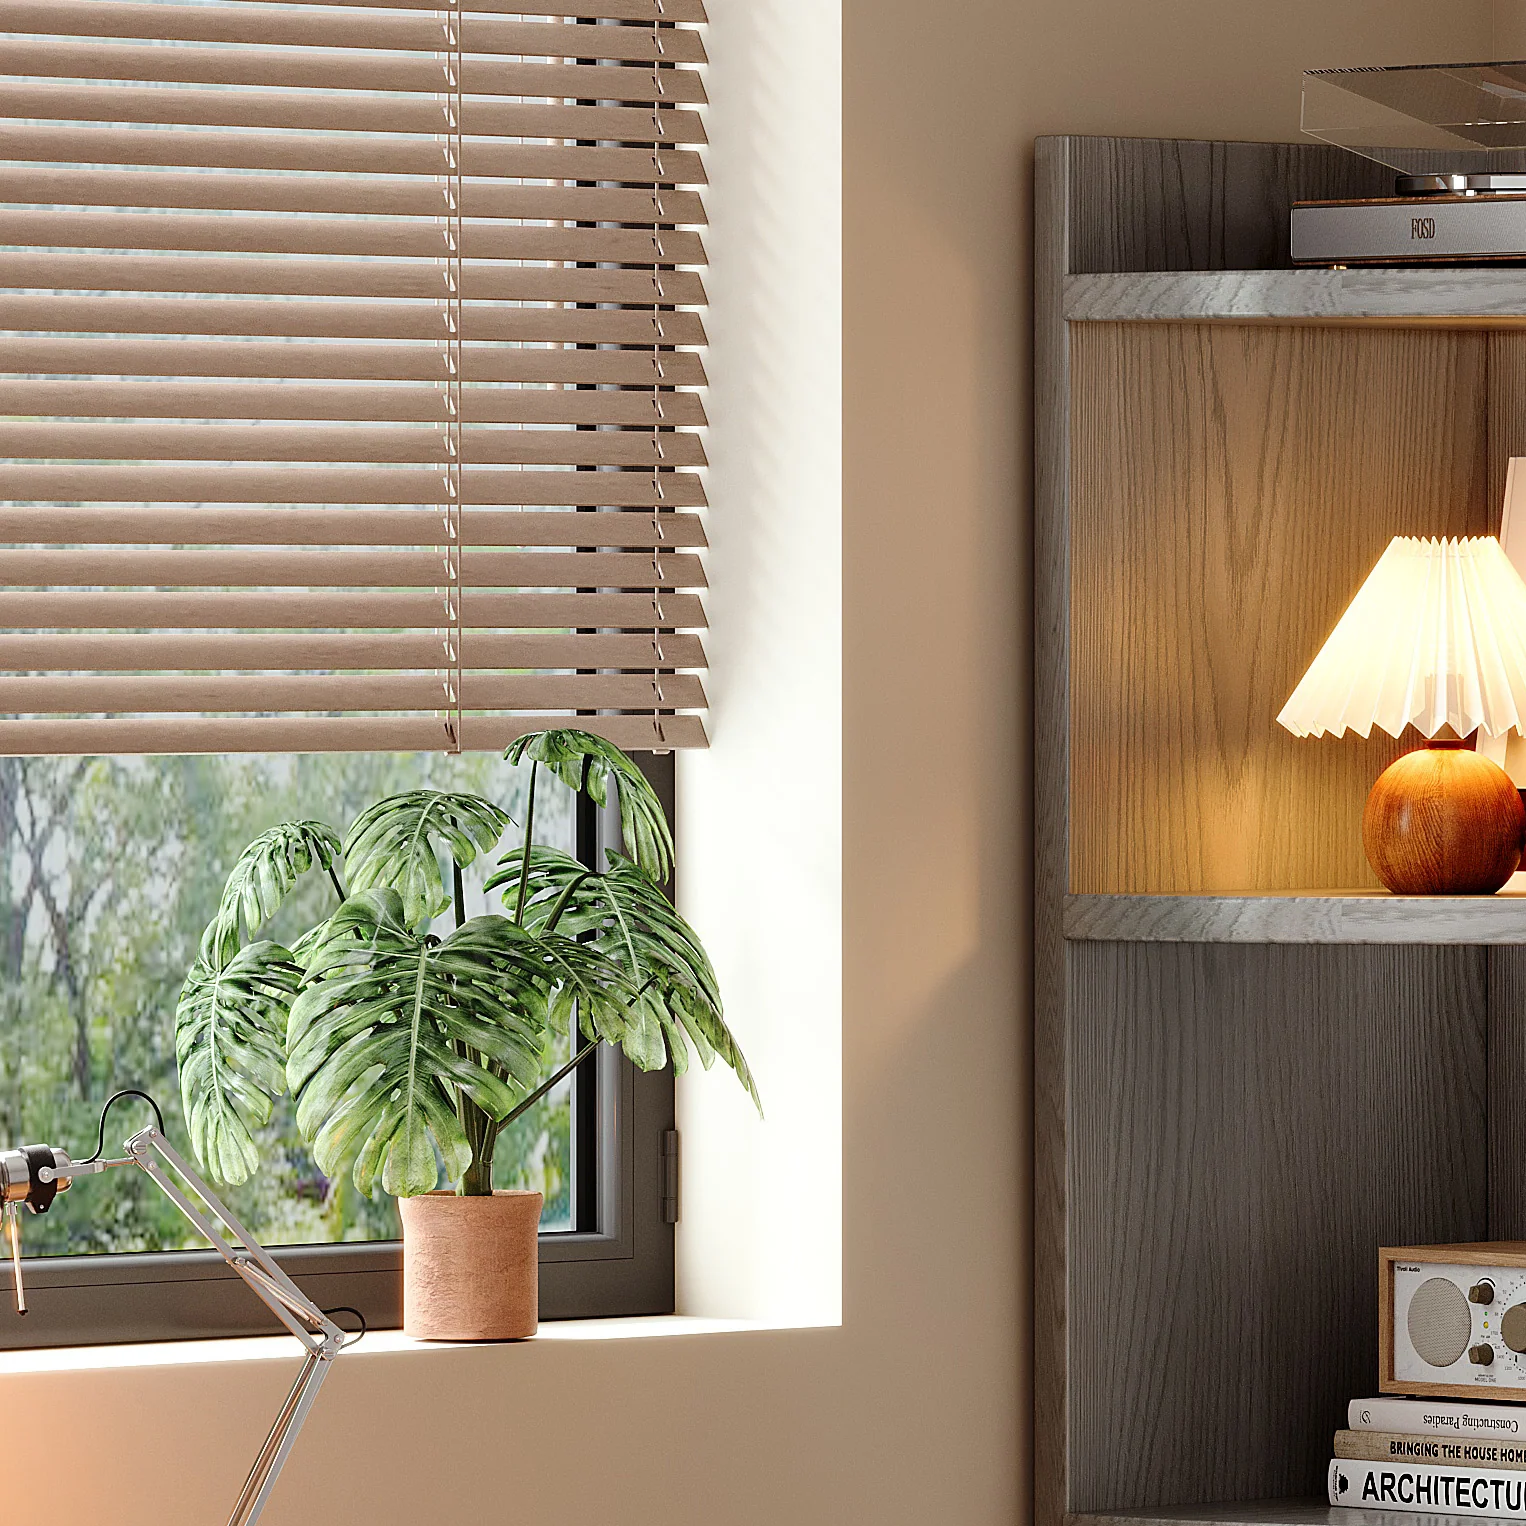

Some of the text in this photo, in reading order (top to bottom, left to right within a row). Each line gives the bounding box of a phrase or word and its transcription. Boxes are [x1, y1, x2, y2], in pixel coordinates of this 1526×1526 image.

[1423, 1414, 1519, 1433] Constructing Paradies
[1389, 1441, 1439, 1458] BRINGING
[1441, 1444, 1462, 1459] THE
[1464, 1446, 1498, 1461] HOUSE
